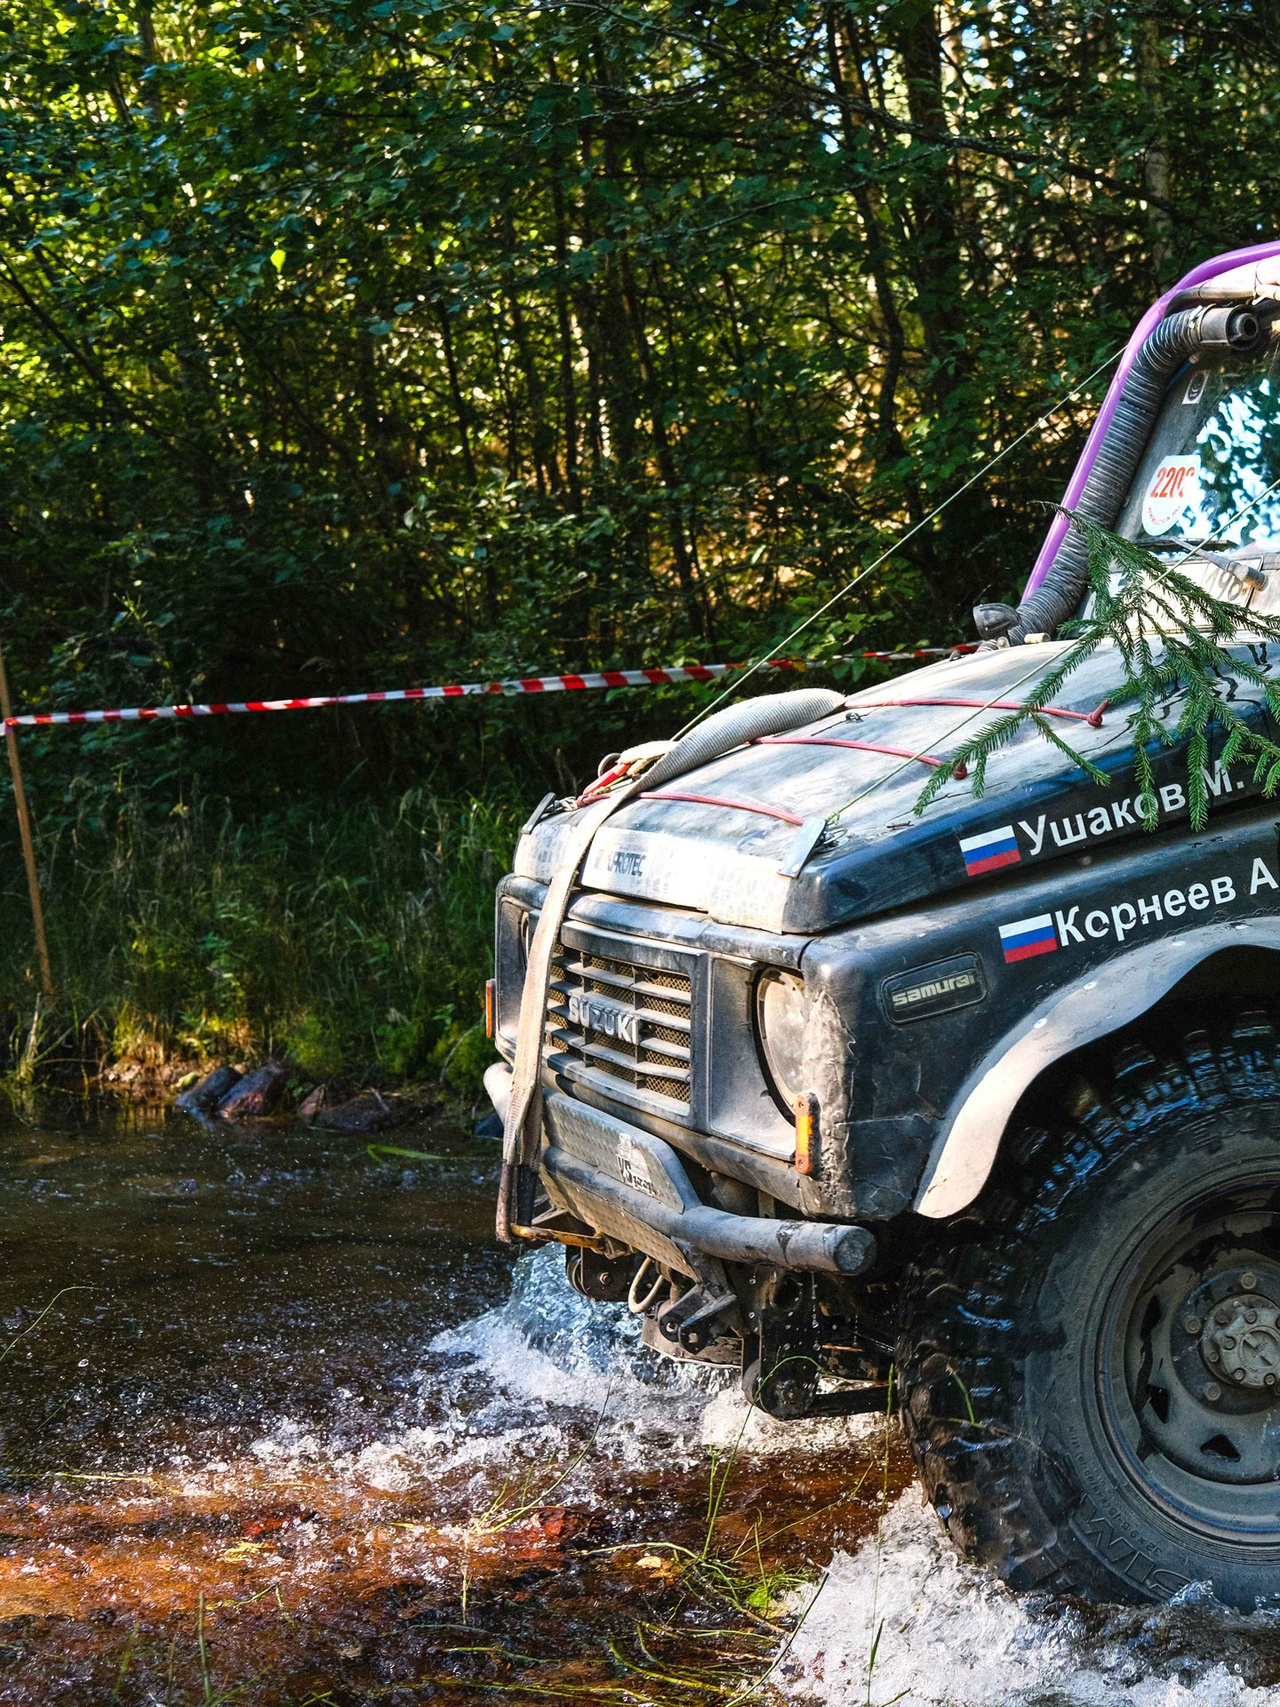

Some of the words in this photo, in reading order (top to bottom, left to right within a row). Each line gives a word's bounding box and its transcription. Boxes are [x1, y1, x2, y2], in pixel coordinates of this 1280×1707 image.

[1017, 782, 1186, 856] Ушаков
[1054, 875, 1237, 947] Корнеев
[568, 994, 641, 1046] SUZUKI
